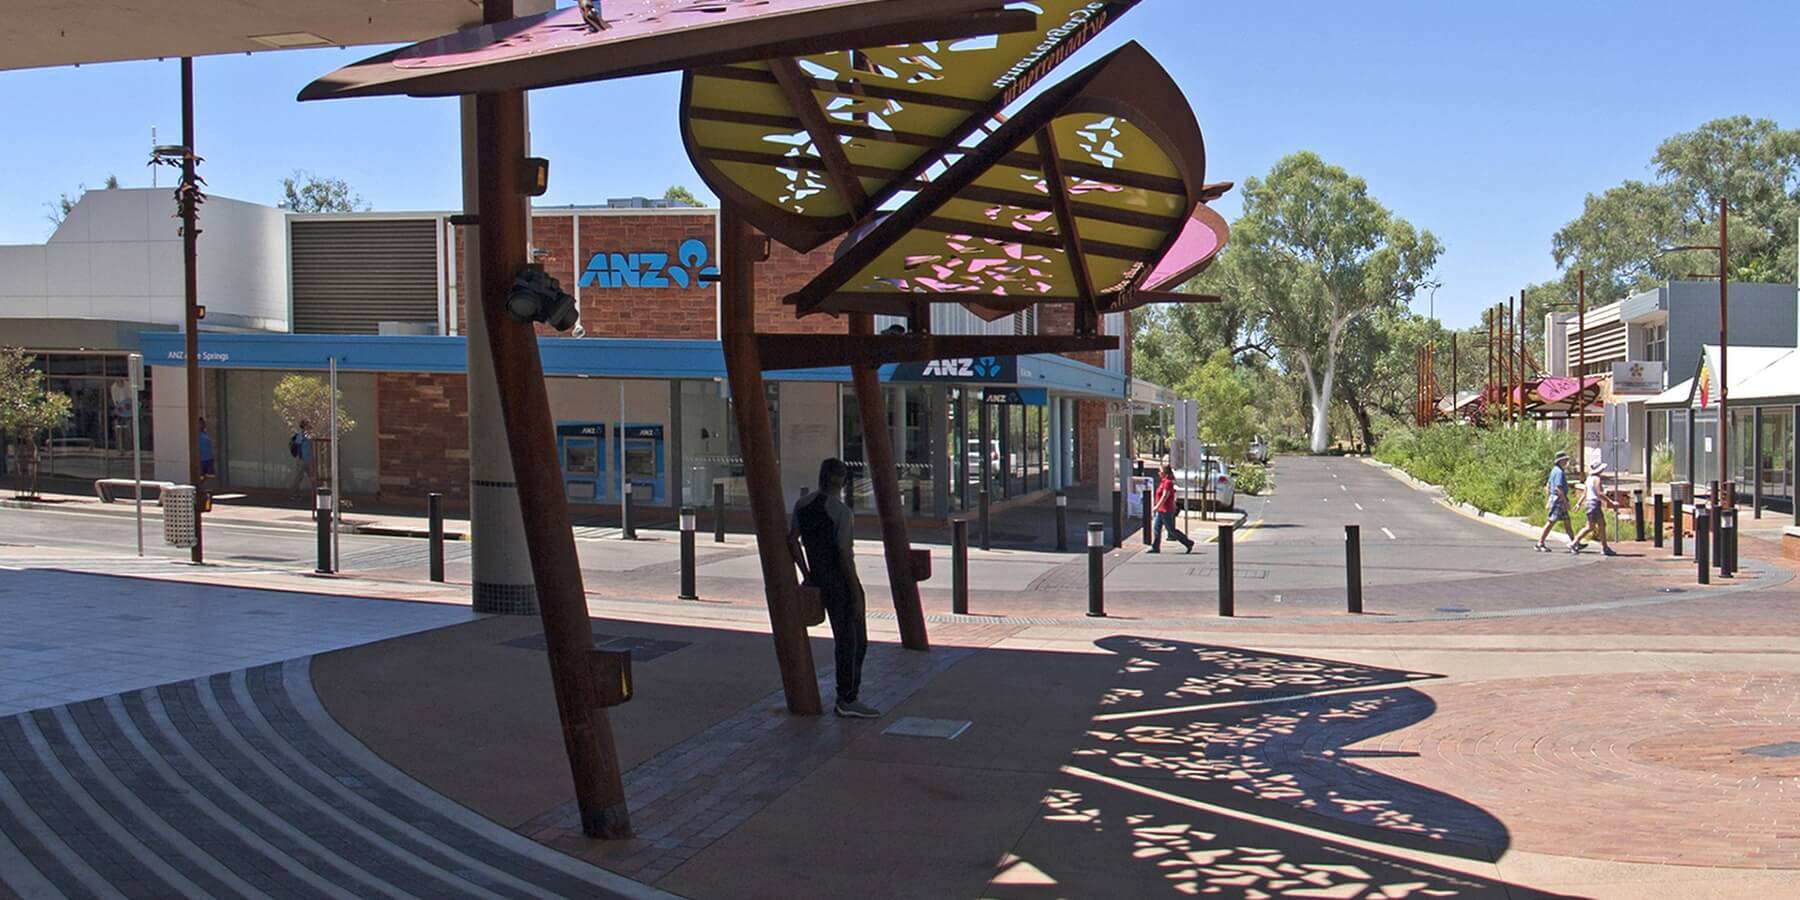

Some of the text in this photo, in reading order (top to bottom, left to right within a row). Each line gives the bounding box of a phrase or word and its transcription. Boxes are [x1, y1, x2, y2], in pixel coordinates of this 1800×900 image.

[578, 253, 669, 288] ANZ
[202, 352, 230, 362] Springs
[922, 357, 974, 377] ANZ
[986, 394, 1007, 403] ANZ
